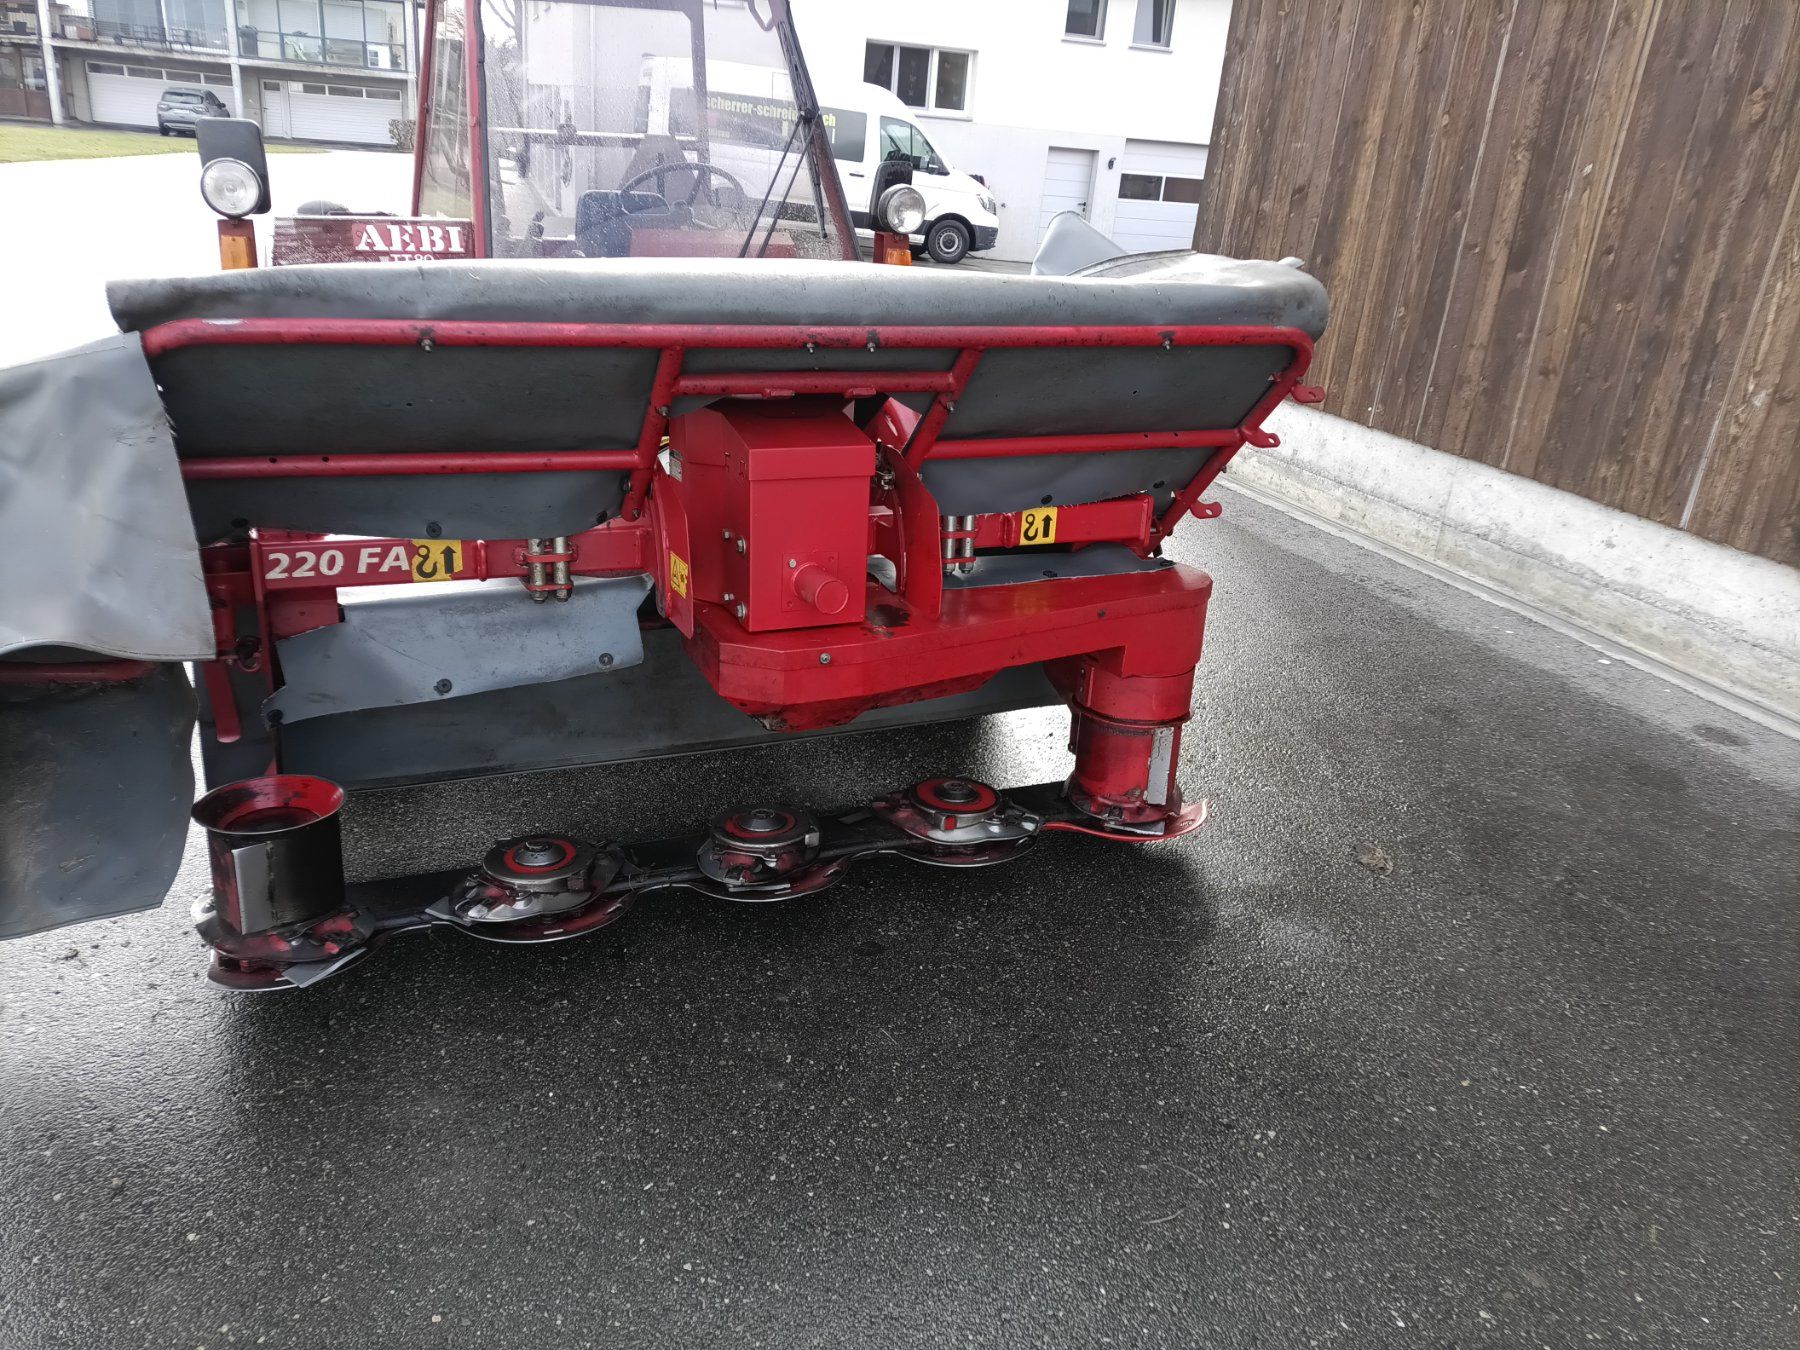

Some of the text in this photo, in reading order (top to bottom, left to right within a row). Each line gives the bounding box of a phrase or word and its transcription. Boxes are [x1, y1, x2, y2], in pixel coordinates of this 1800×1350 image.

[355, 224, 466, 254] AEBI
[264, 545, 411, 580] 220 FA
